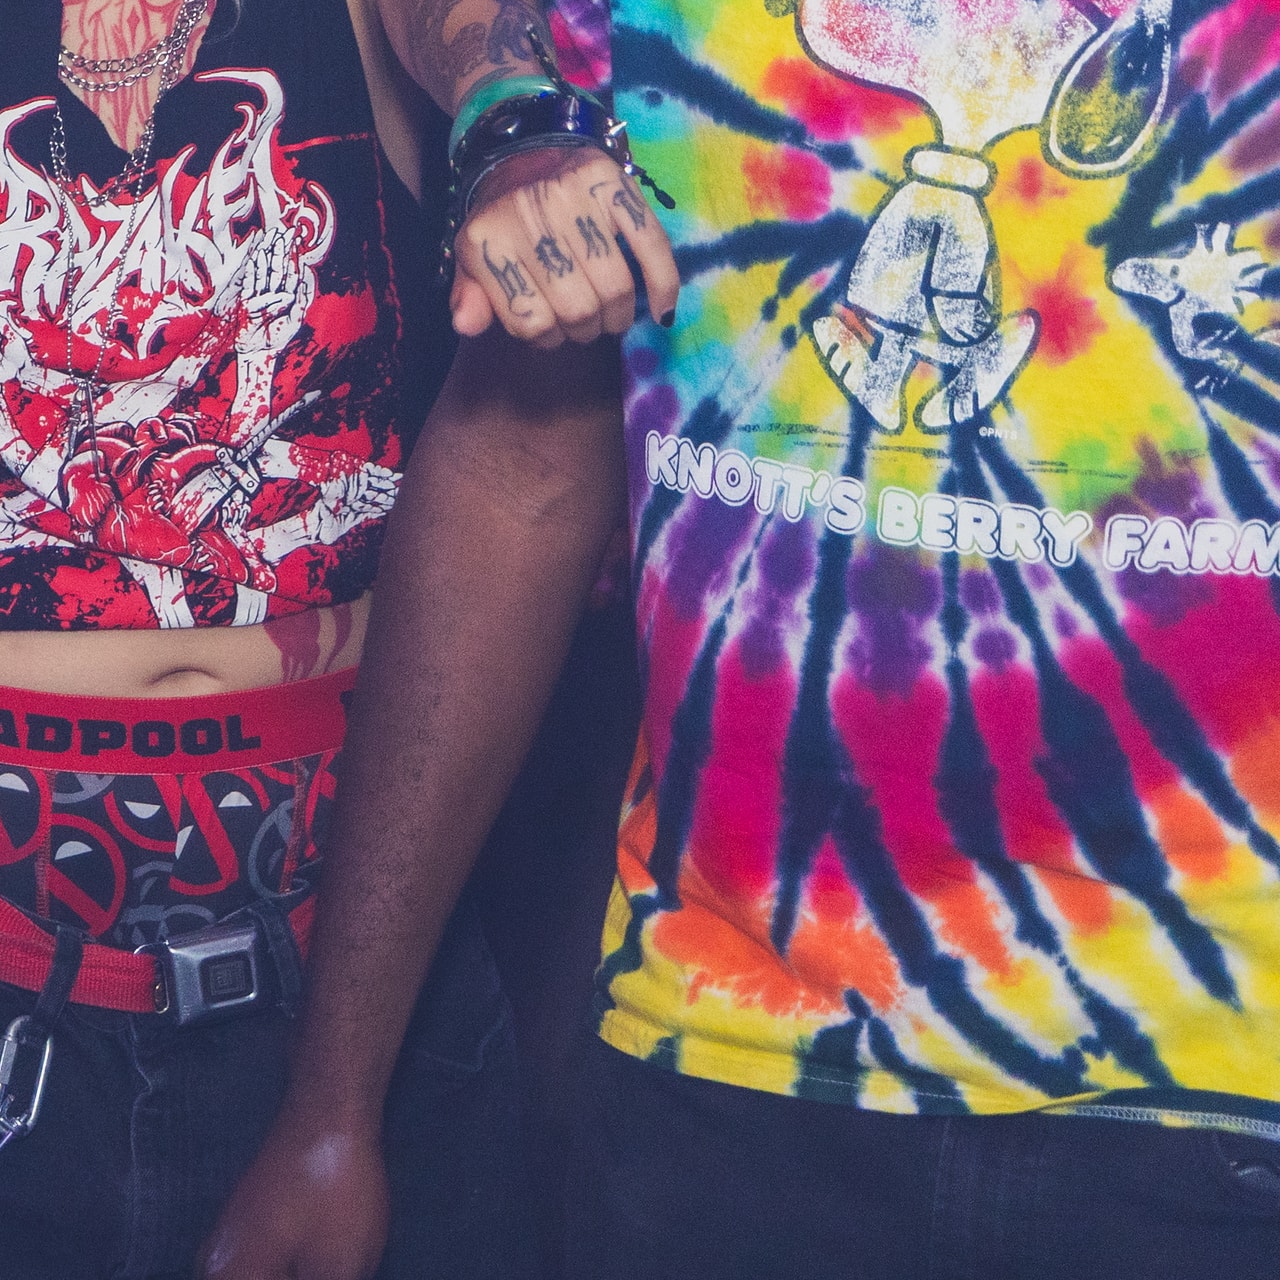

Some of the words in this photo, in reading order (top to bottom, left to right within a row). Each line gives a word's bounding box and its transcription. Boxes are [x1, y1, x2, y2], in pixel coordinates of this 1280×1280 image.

[644, 431, 867, 536] KNOTT'S
[876, 486, 1092, 568] BERRY
[1104, 515, 1280, 577] FARM
